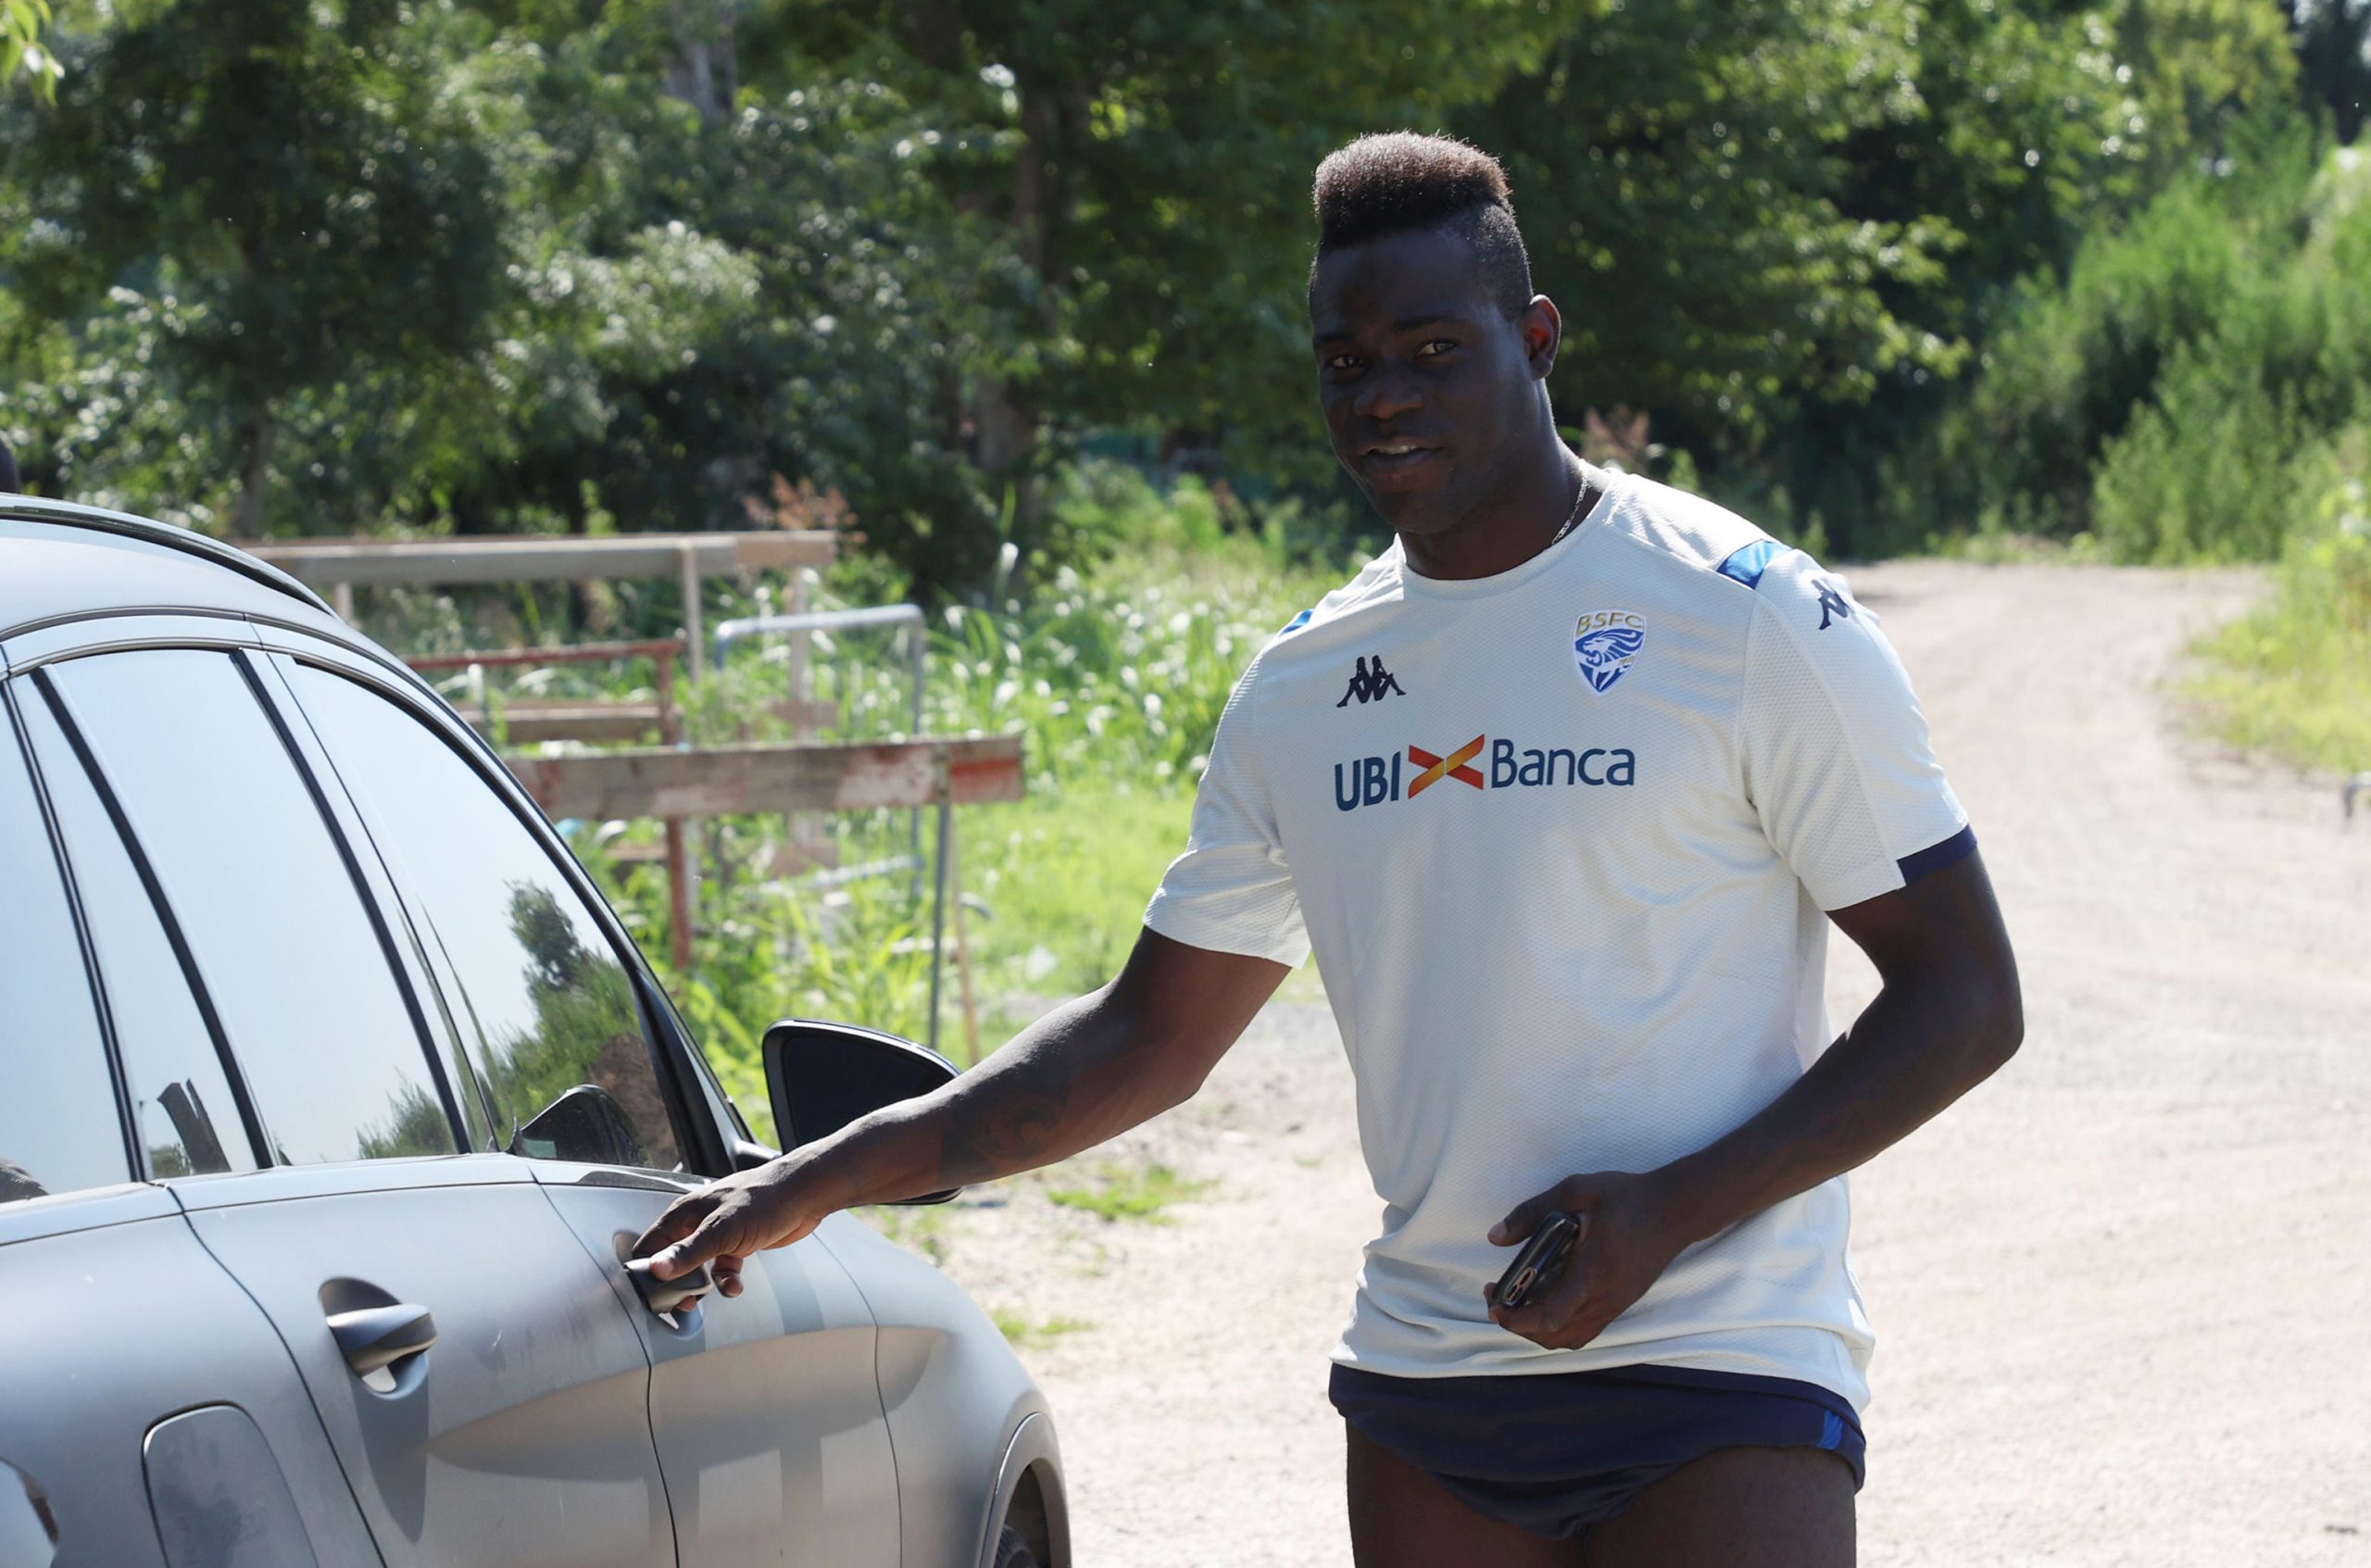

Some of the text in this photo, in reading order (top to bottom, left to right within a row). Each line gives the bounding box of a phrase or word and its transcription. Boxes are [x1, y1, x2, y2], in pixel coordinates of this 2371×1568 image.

[1576, 612, 1643, 635] BSFC
[1336, 739, 1635, 811] UBI Banca
